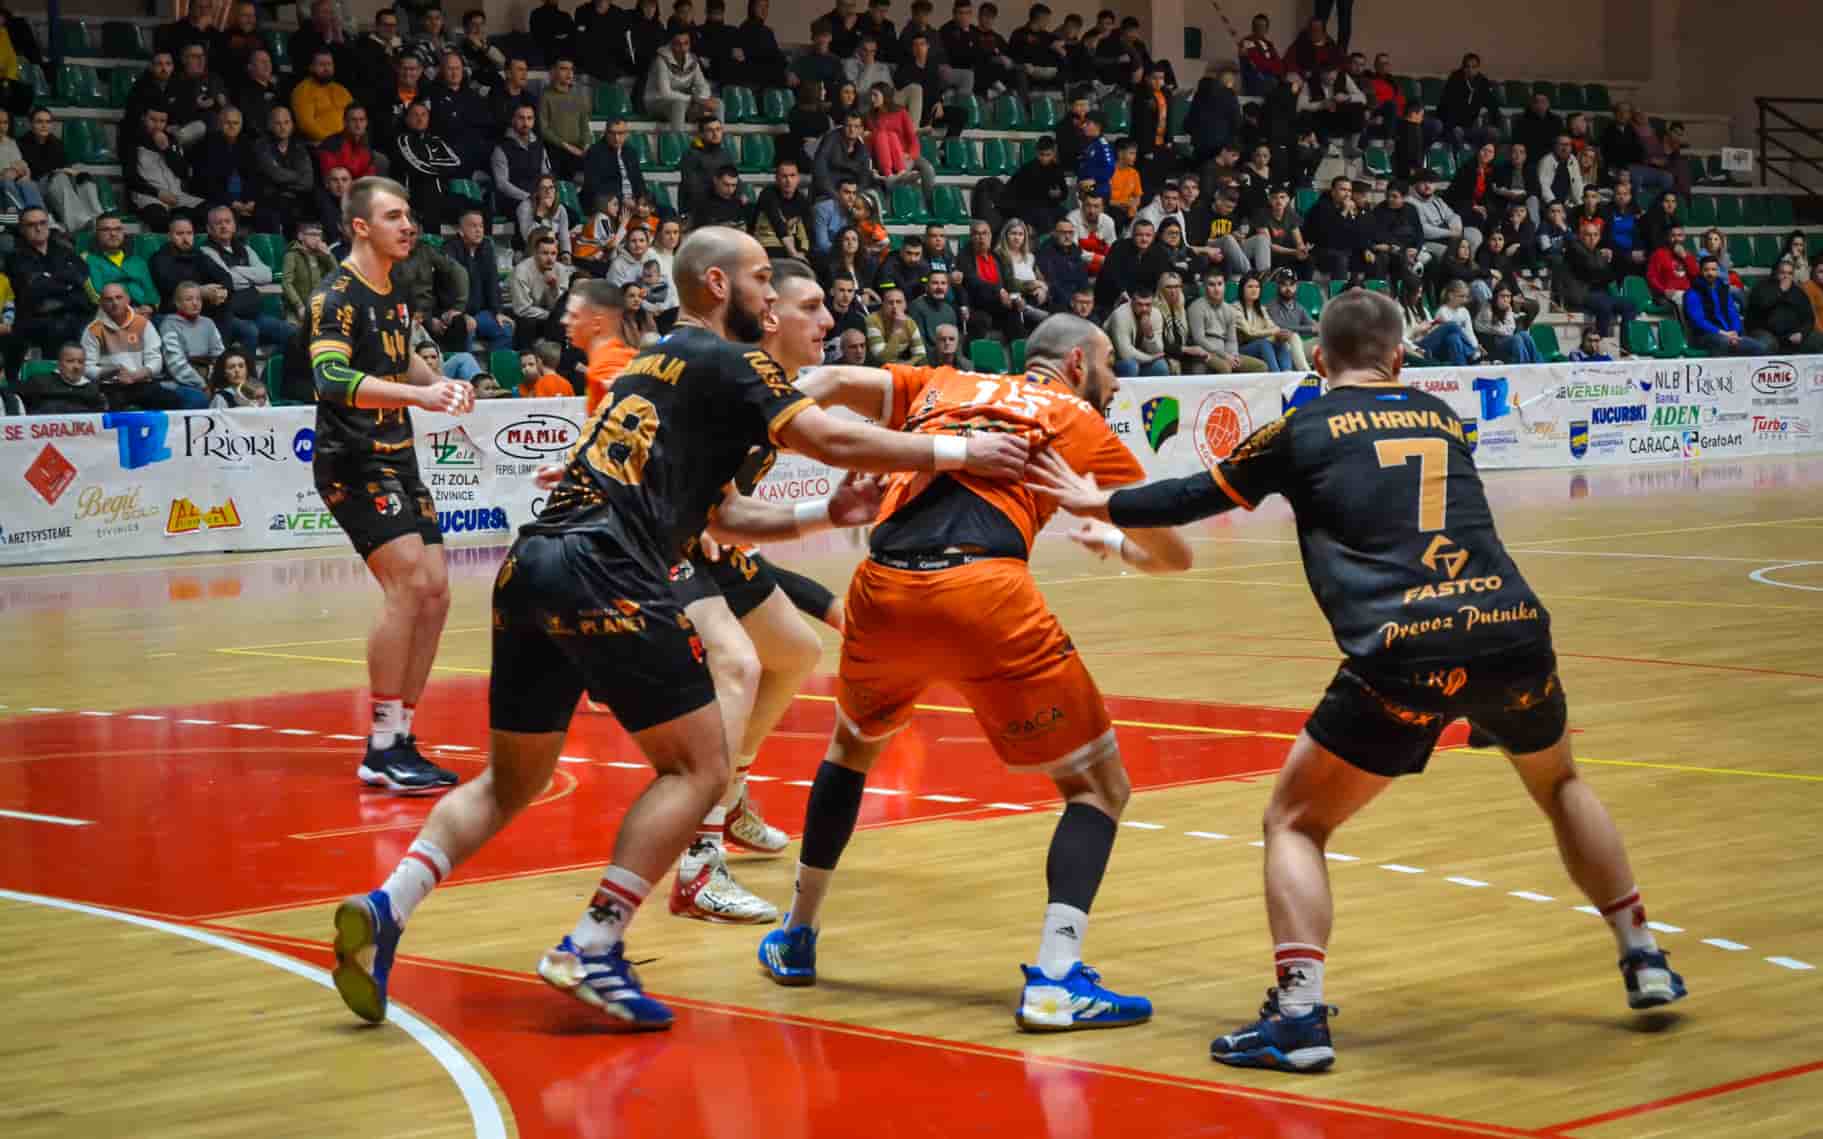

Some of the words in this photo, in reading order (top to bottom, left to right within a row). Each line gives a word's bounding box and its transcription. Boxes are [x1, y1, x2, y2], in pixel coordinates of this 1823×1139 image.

[1655, 371, 1681, 390] NLB
[1592, 404, 1647, 424] KUCURSKI
[1651, 405, 1700, 427] ADEN
[5, 425, 24, 441] SE
[1328, 411, 1369, 439] RH
[1752, 416, 1789, 433] Turbo
[1630, 436, 1680, 454] CARACA
[1700, 434, 1743, 449] GrafoArt
[431, 474, 446, 486] ZH
[448, 473, 480, 486] ZOLA
[758, 478, 830, 499] KAVGICO
[1373, 438, 1449, 533] 7
[1402, 576, 1503, 605] FASTCO
[1378, 616, 1455, 649] Prevoz
[1457, 601, 1539, 632] Putnika
